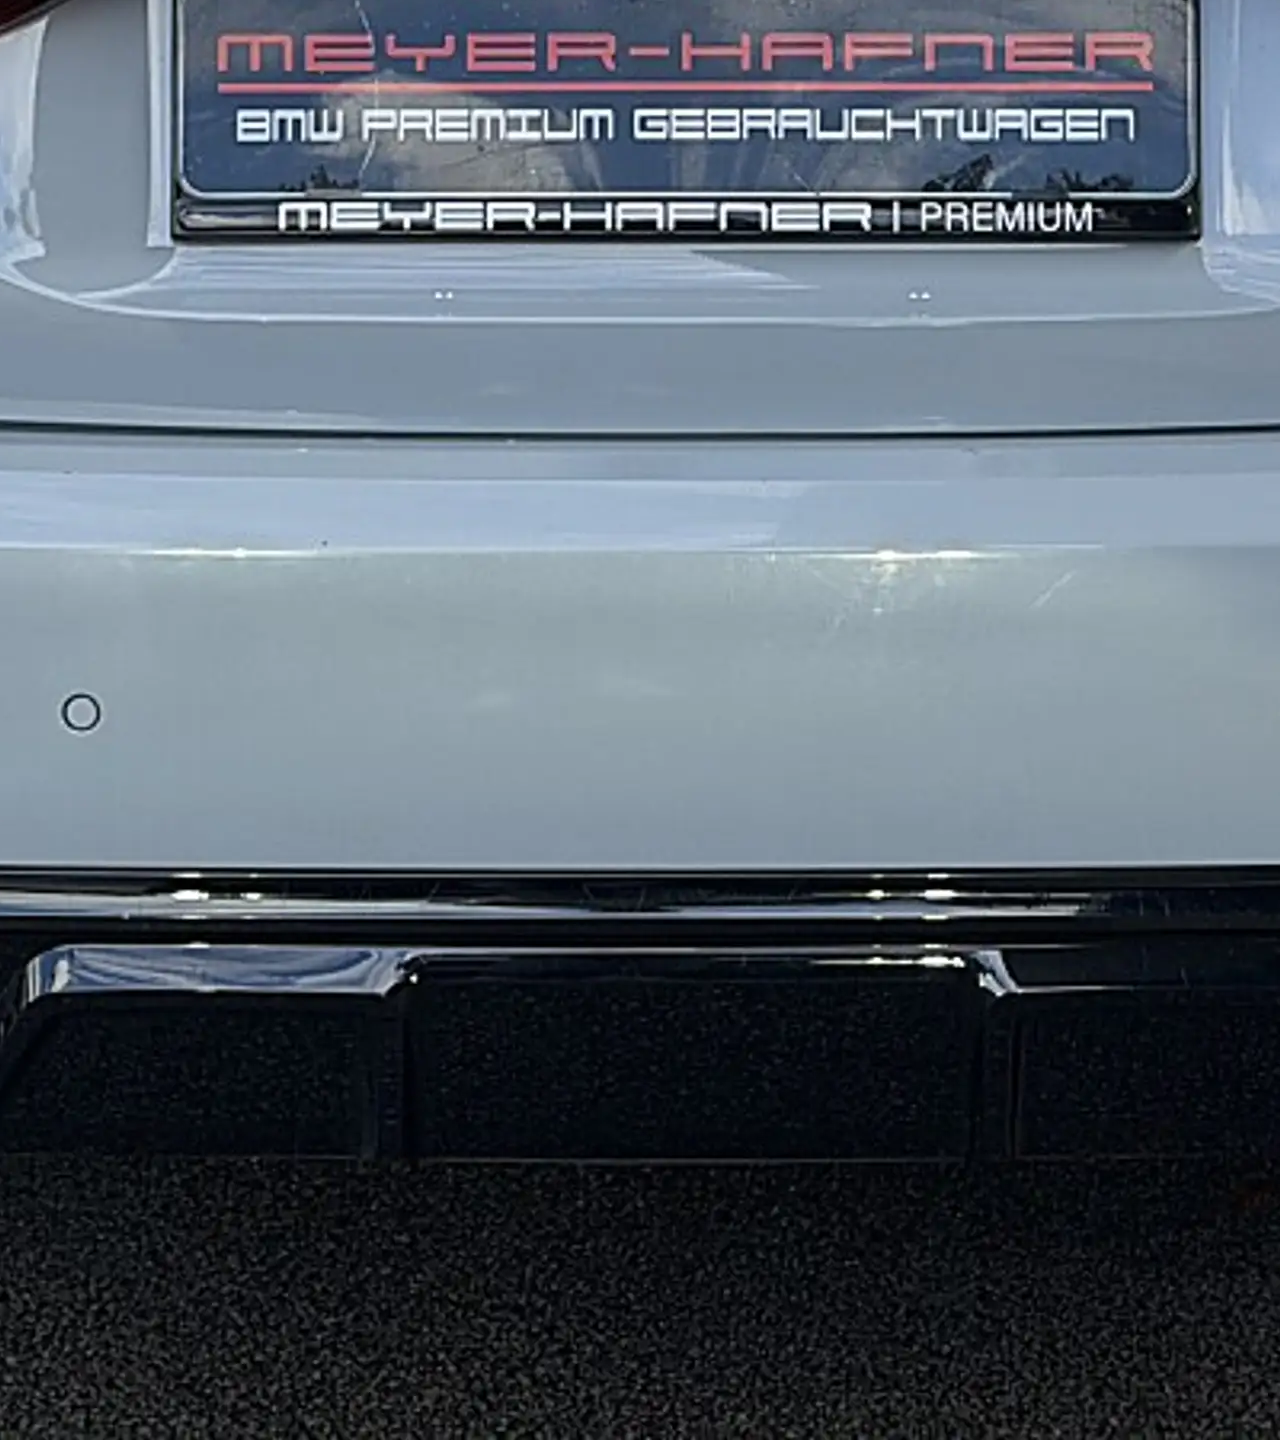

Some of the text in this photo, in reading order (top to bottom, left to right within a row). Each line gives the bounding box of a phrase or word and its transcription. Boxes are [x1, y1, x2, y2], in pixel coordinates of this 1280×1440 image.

[217, 32, 1154, 73] MEYER-HAFNER
[236, 107, 1136, 143] BMW PREMIUM GEBRAUCHTWAGEN
[277, 200, 1094, 233] MEYER-HAFNER PREMIUM
